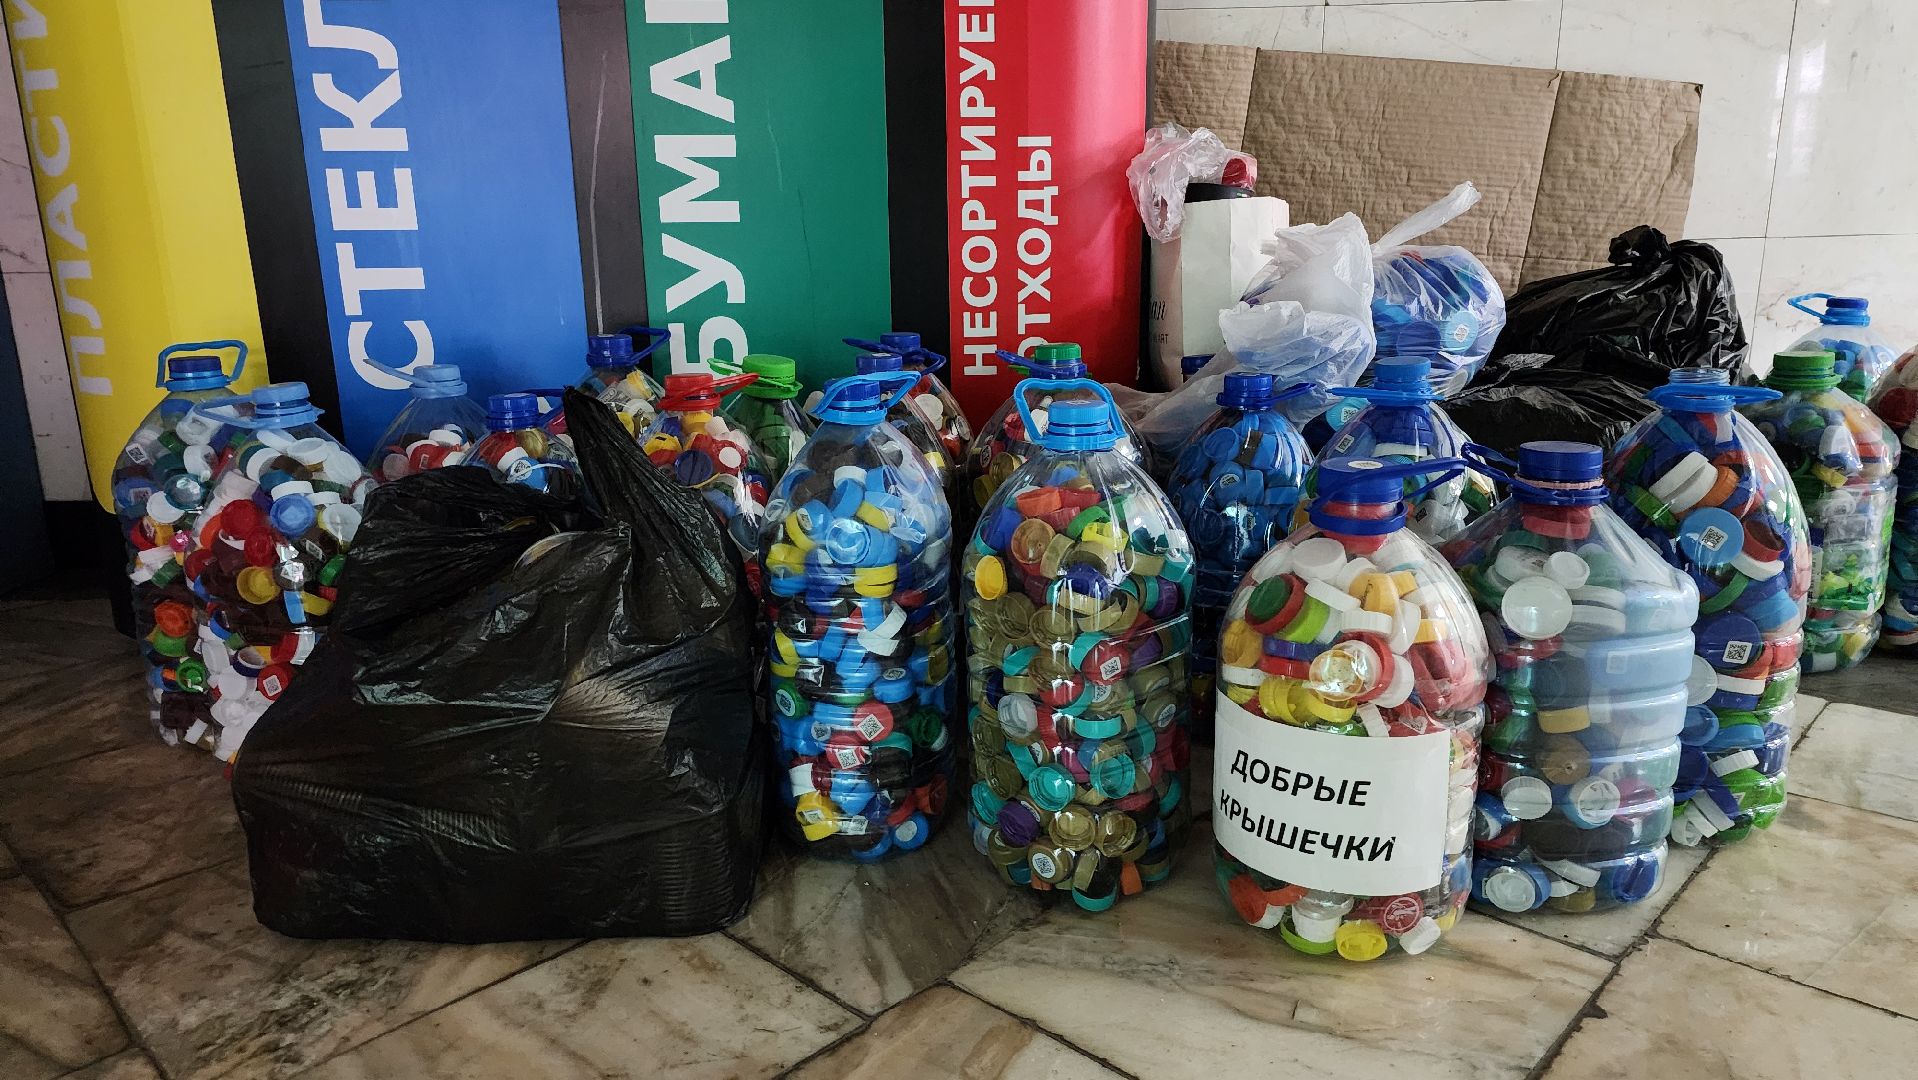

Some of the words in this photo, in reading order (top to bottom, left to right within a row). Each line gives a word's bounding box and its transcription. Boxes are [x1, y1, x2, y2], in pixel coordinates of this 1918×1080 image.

[303, 0, 435, 390] СТЕКЛ
[959, 0, 999, 376] НЕСОРТИРУЕ
[1220, 789, 1396, 861] КРЫШЕЧКИ
[1231, 750, 1371, 806] ДОБРЫЕ
